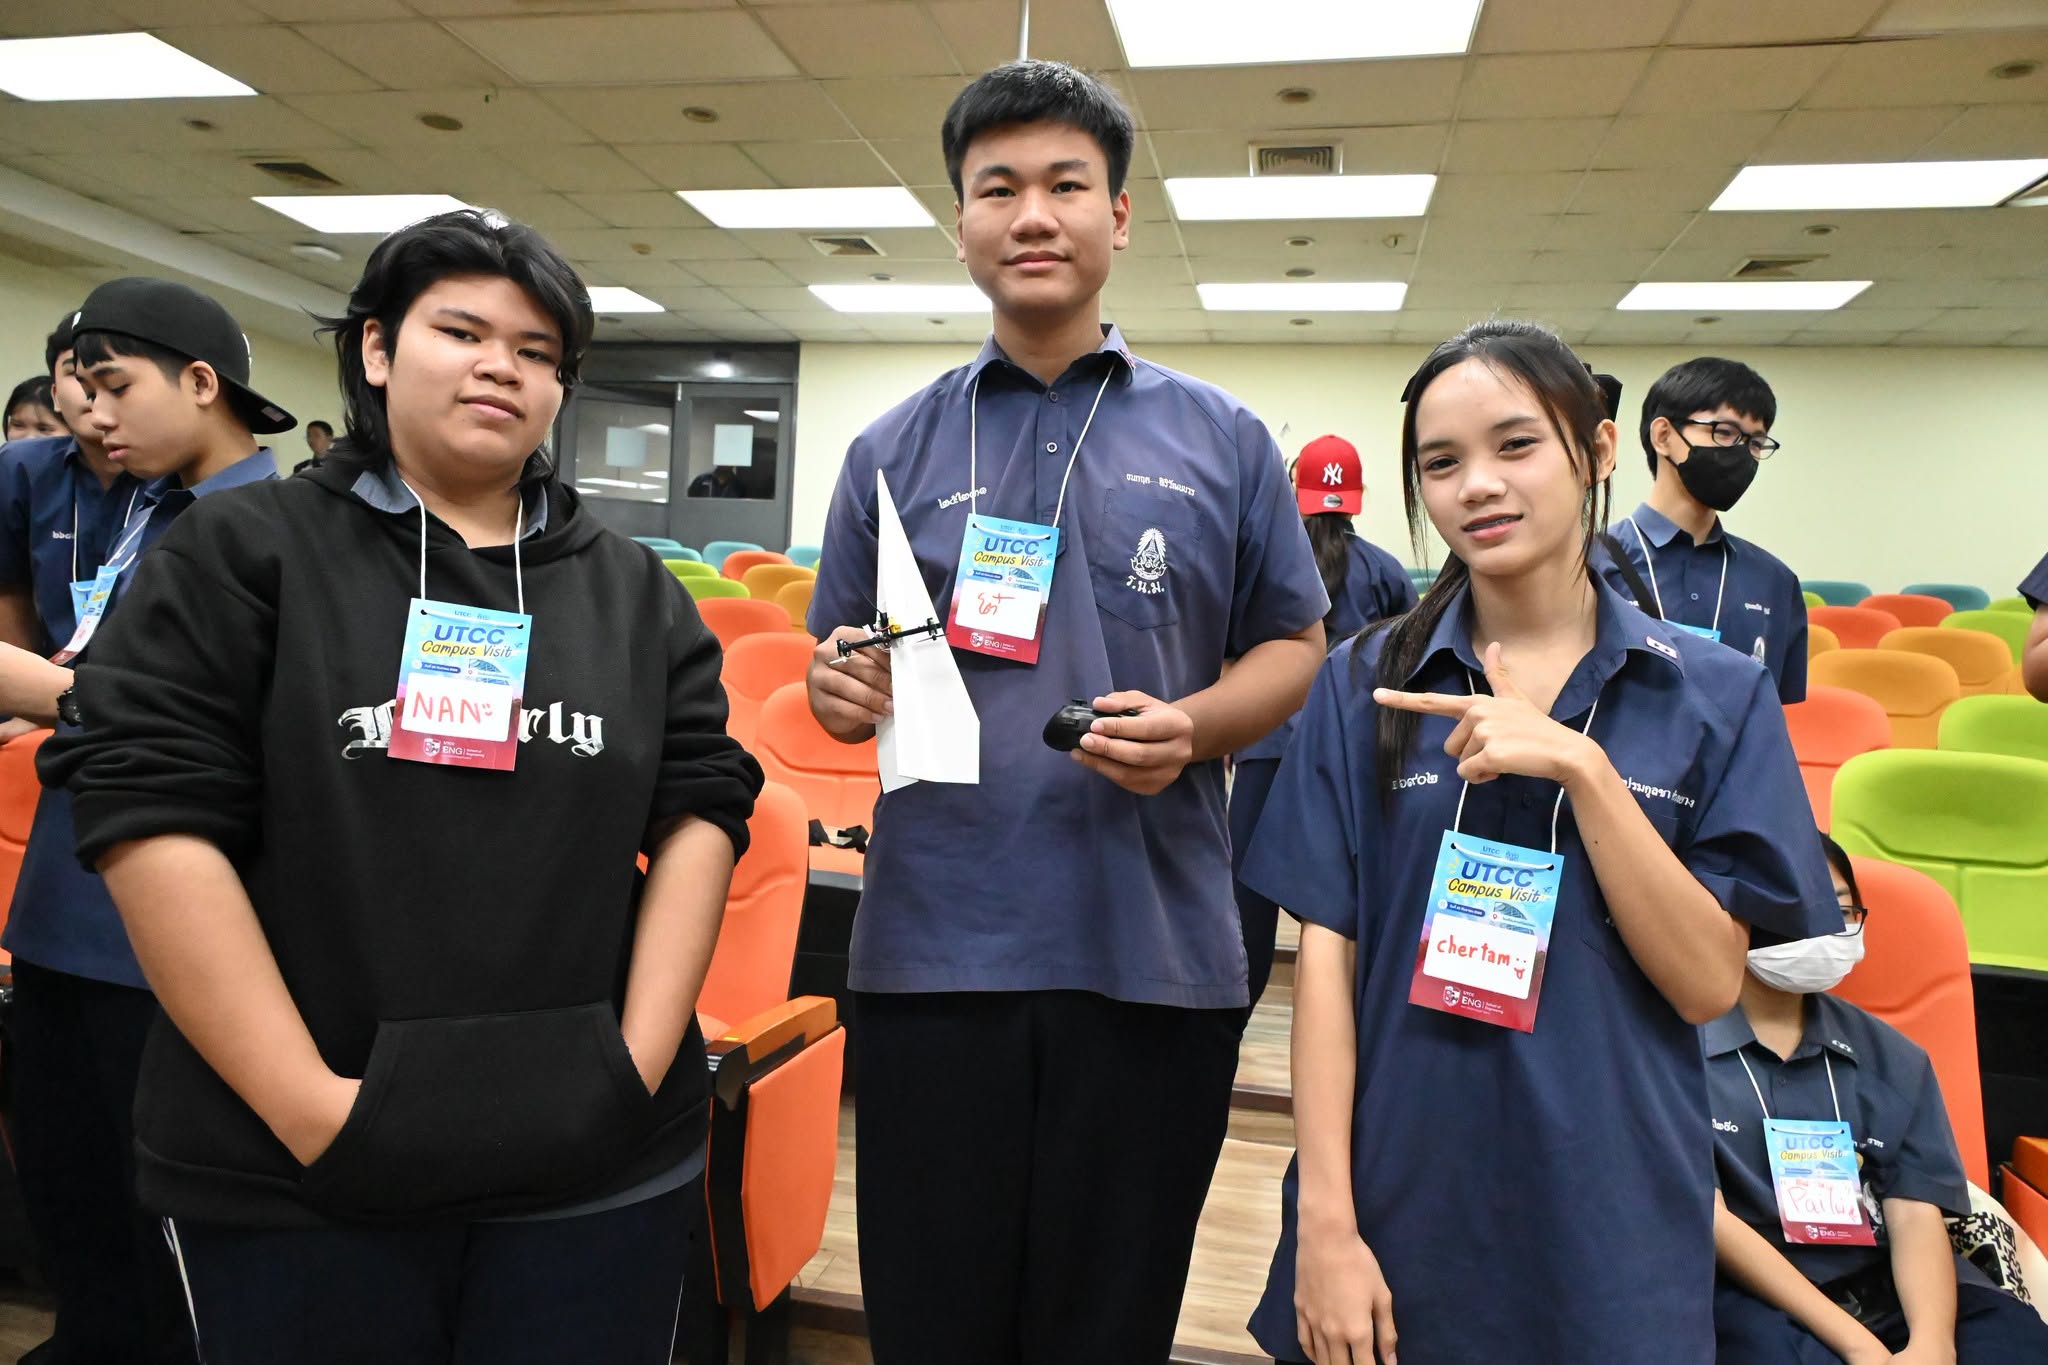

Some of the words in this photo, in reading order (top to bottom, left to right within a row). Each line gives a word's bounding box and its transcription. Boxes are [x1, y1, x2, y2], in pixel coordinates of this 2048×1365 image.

[984, 537, 1040, 555] UTCC
[974, 551, 1016, 566] Campus
[1021, 555, 1045, 567] Visit
[434, 624, 505, 645] UTCC
[421, 640, 476, 657] Campus
[483, 644, 512, 658] Visit
[984, 639, 1000, 648] ENG
[412, 691, 481, 724] NAN
[442, 745, 463, 755] ENG
[1461, 861, 1534, 888] UTCC
[1448, 878, 1503, 898] Campus
[1509, 886, 1541, 903] Visit
[1461, 996, 1482, 1008] ENG
[1785, 1135, 1834, 1150] UTCC
[1780, 1150, 1818, 1162] Campus
[1822, 1149, 1843, 1160] Visit
